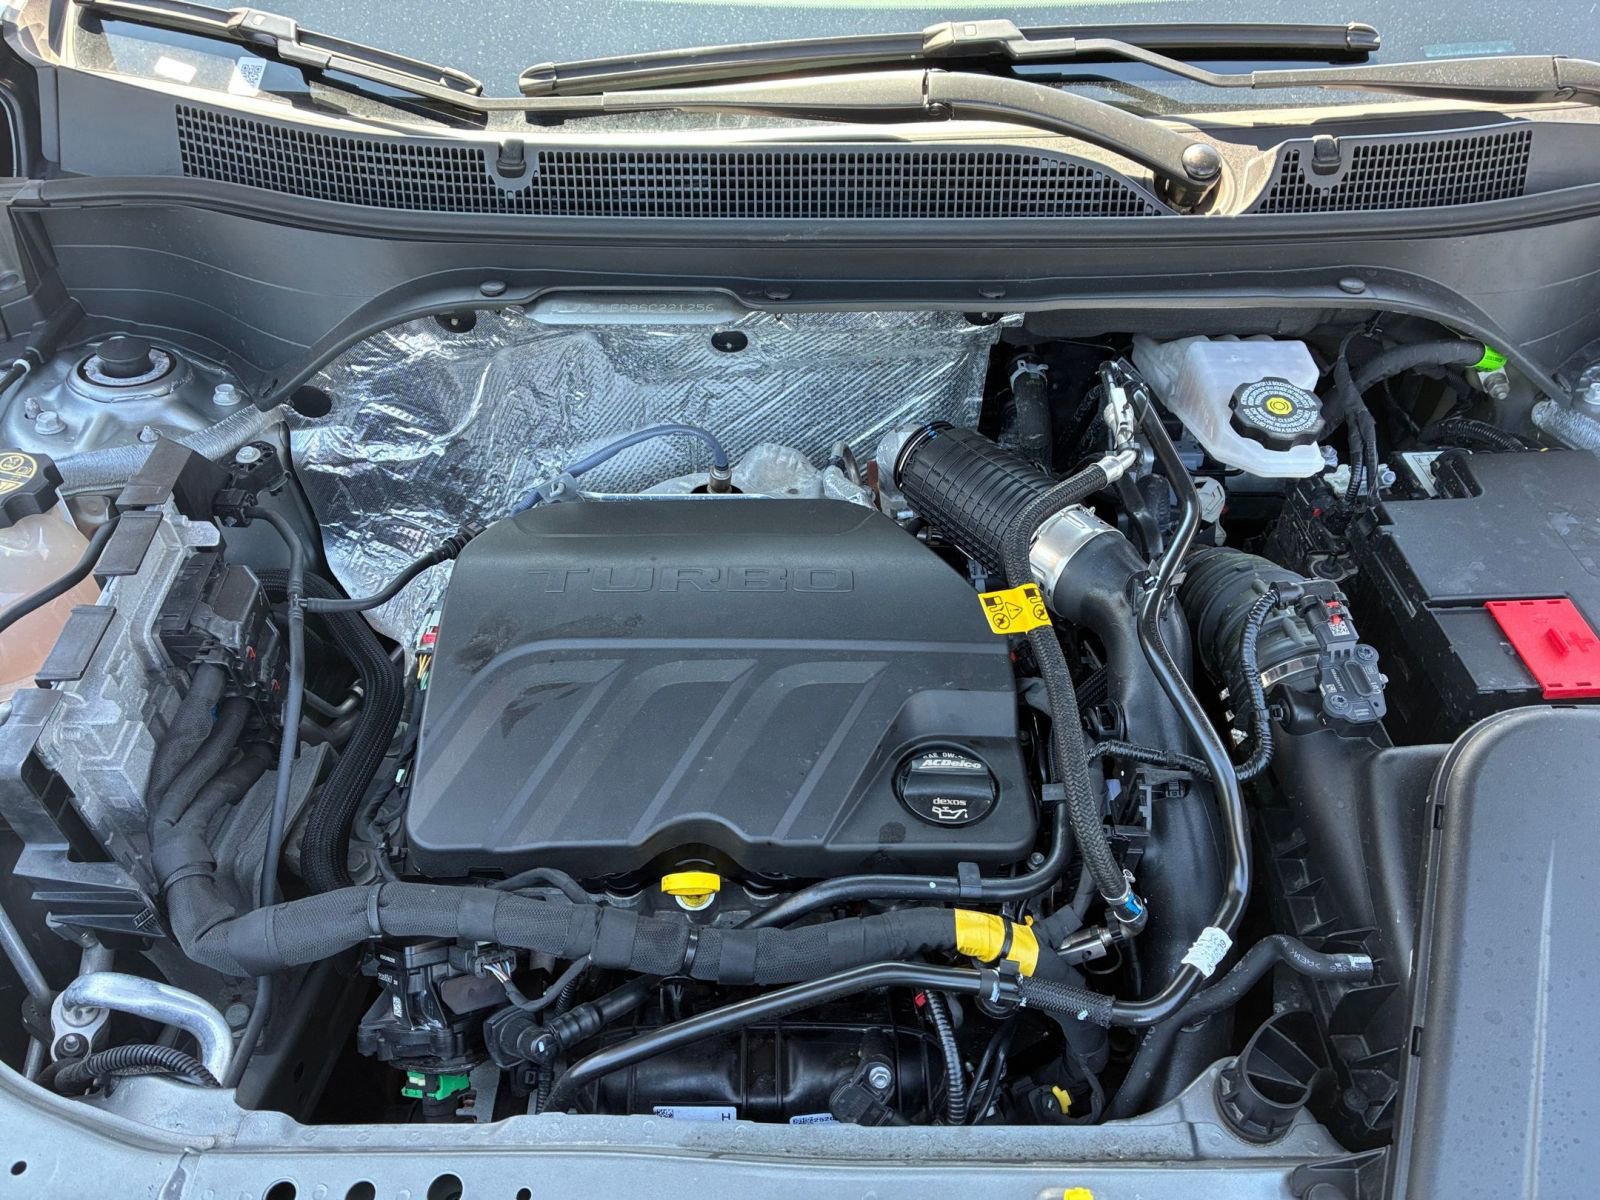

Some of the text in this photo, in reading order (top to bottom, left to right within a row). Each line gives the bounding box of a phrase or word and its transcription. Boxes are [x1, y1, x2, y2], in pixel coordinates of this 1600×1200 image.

[527, 567, 855, 593] TURBO
[921, 759, 982, 769] ACDelco
[933, 797, 967, 806] dexos
